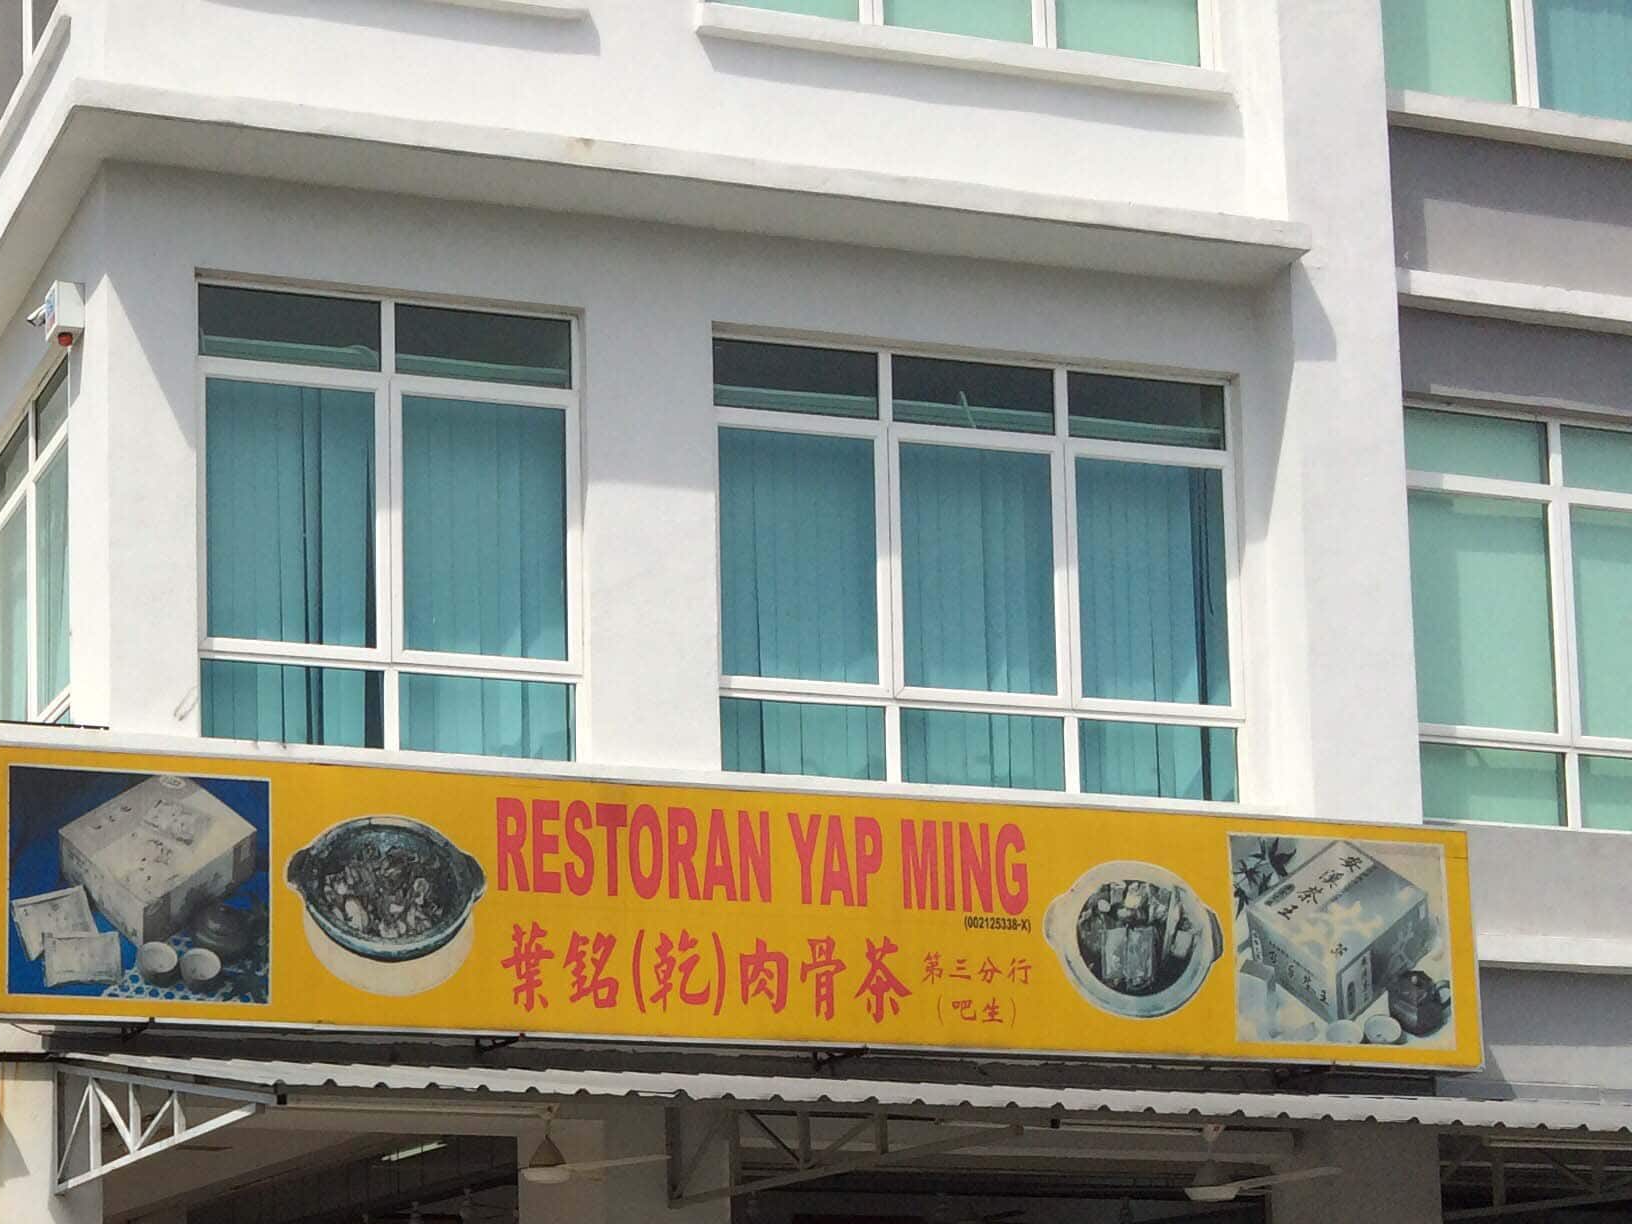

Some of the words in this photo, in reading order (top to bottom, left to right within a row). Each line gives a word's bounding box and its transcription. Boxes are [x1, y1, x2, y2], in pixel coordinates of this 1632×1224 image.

[496, 797, 773, 904] RESTORAN
[787, 813, 884, 907] YAP
[900, 819, 1029, 916] MING
[964, 916, 1032, 933] (002125338-X)
[920, 952, 1033, 986] 第三分行
